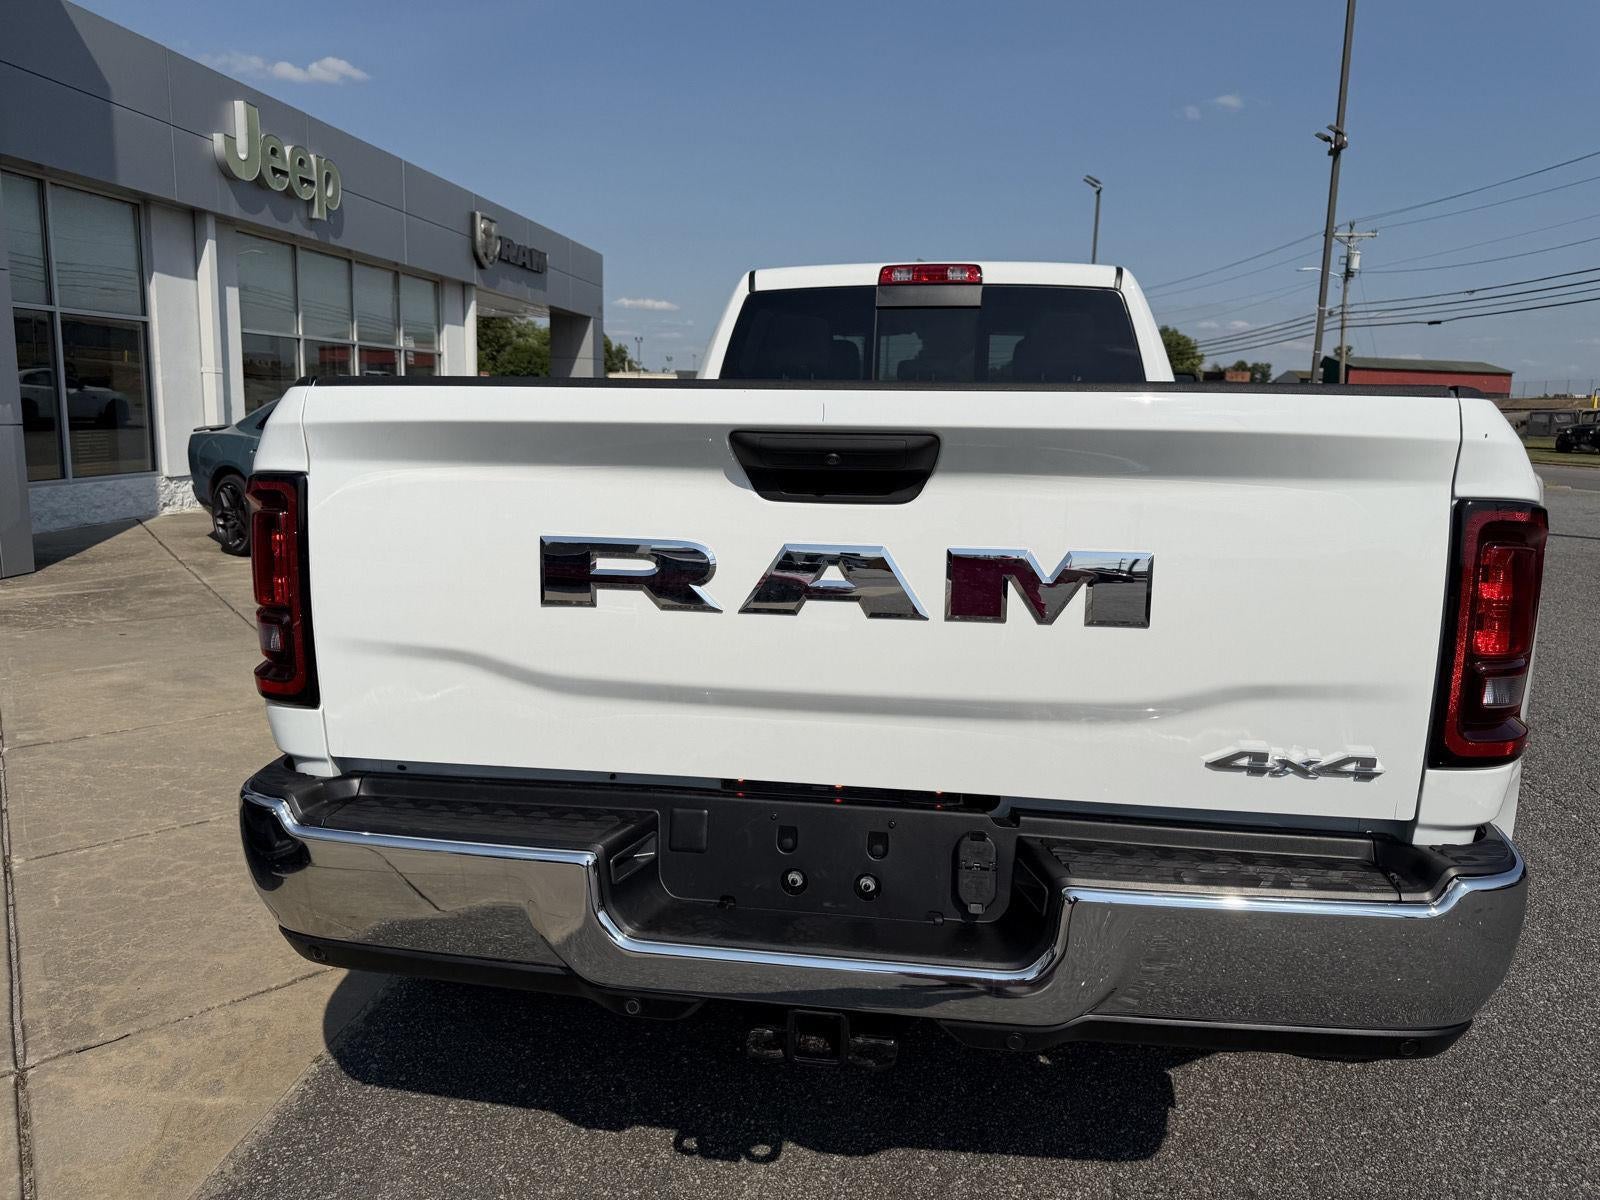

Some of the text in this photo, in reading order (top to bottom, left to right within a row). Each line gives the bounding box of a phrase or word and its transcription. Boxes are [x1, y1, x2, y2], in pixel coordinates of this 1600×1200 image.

[213, 100, 342, 220] Jeep
[499, 236, 548, 274] RAM
[540, 535, 1155, 628] RAM
